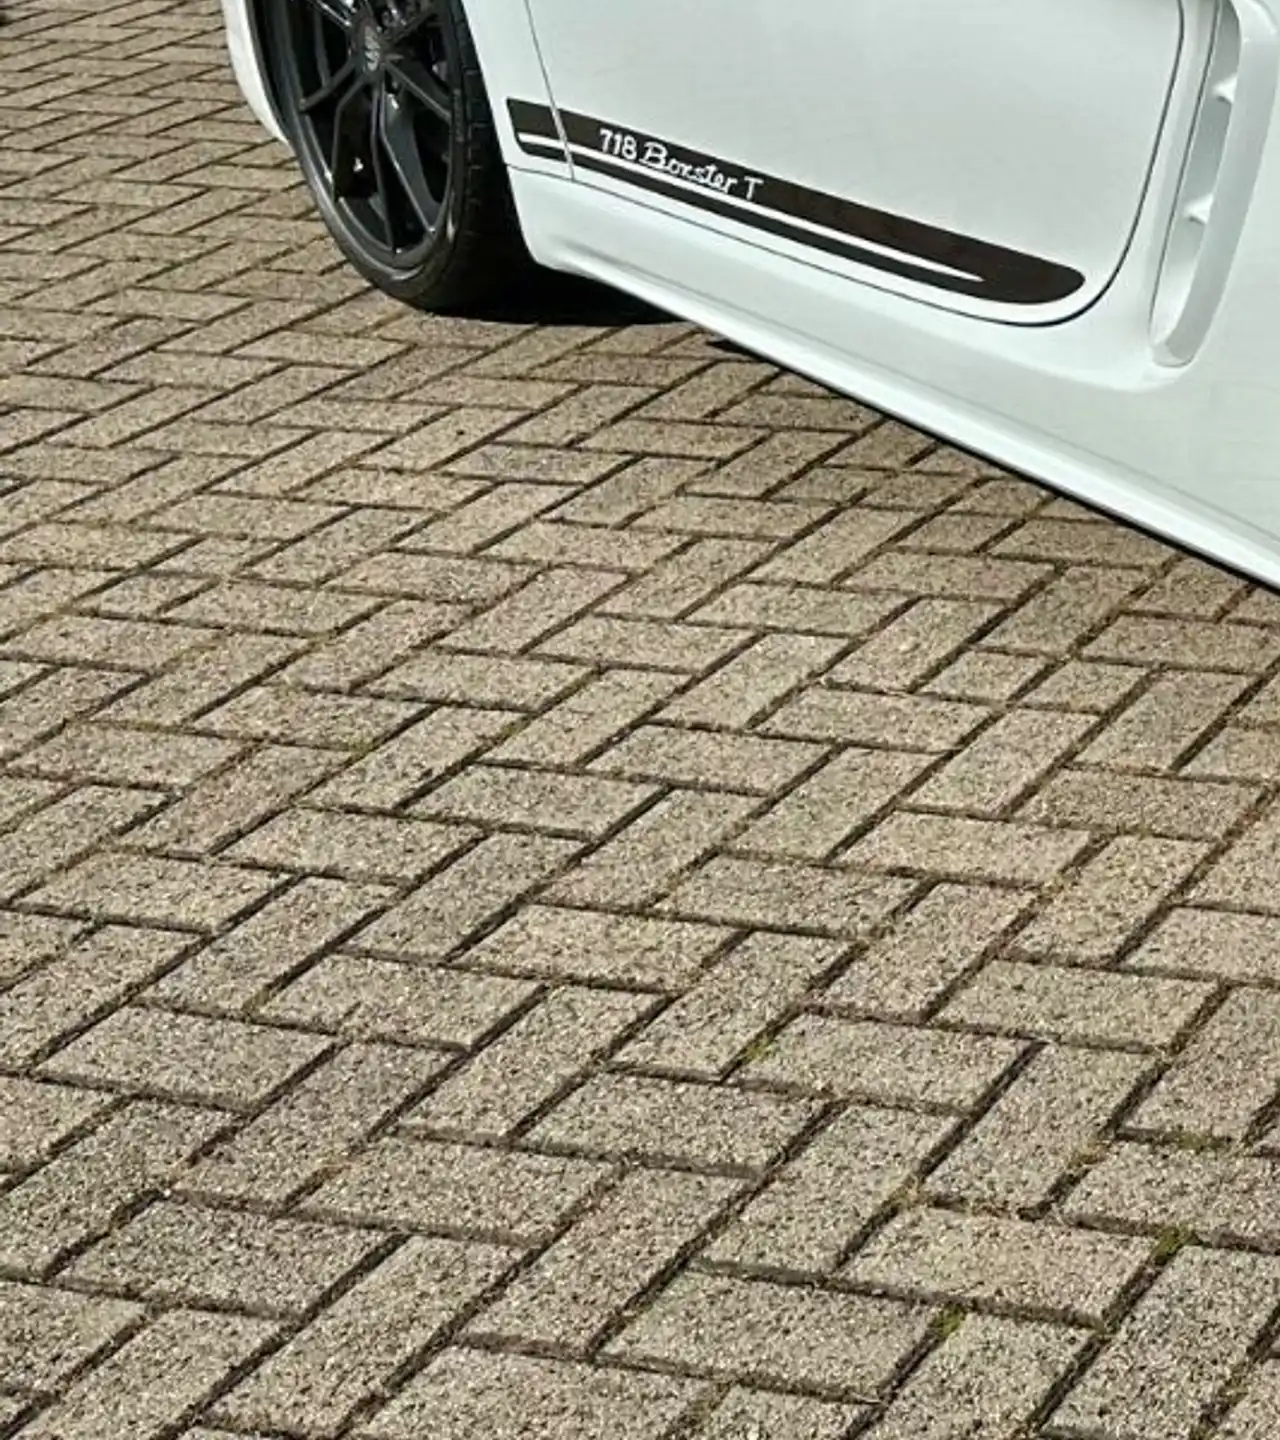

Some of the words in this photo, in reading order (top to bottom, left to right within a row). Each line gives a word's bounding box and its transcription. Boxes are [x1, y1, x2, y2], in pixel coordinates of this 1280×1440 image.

[600, 128, 638, 160] 718
[639, 141, 739, 194] Boxster
[743, 175, 765, 201] T
